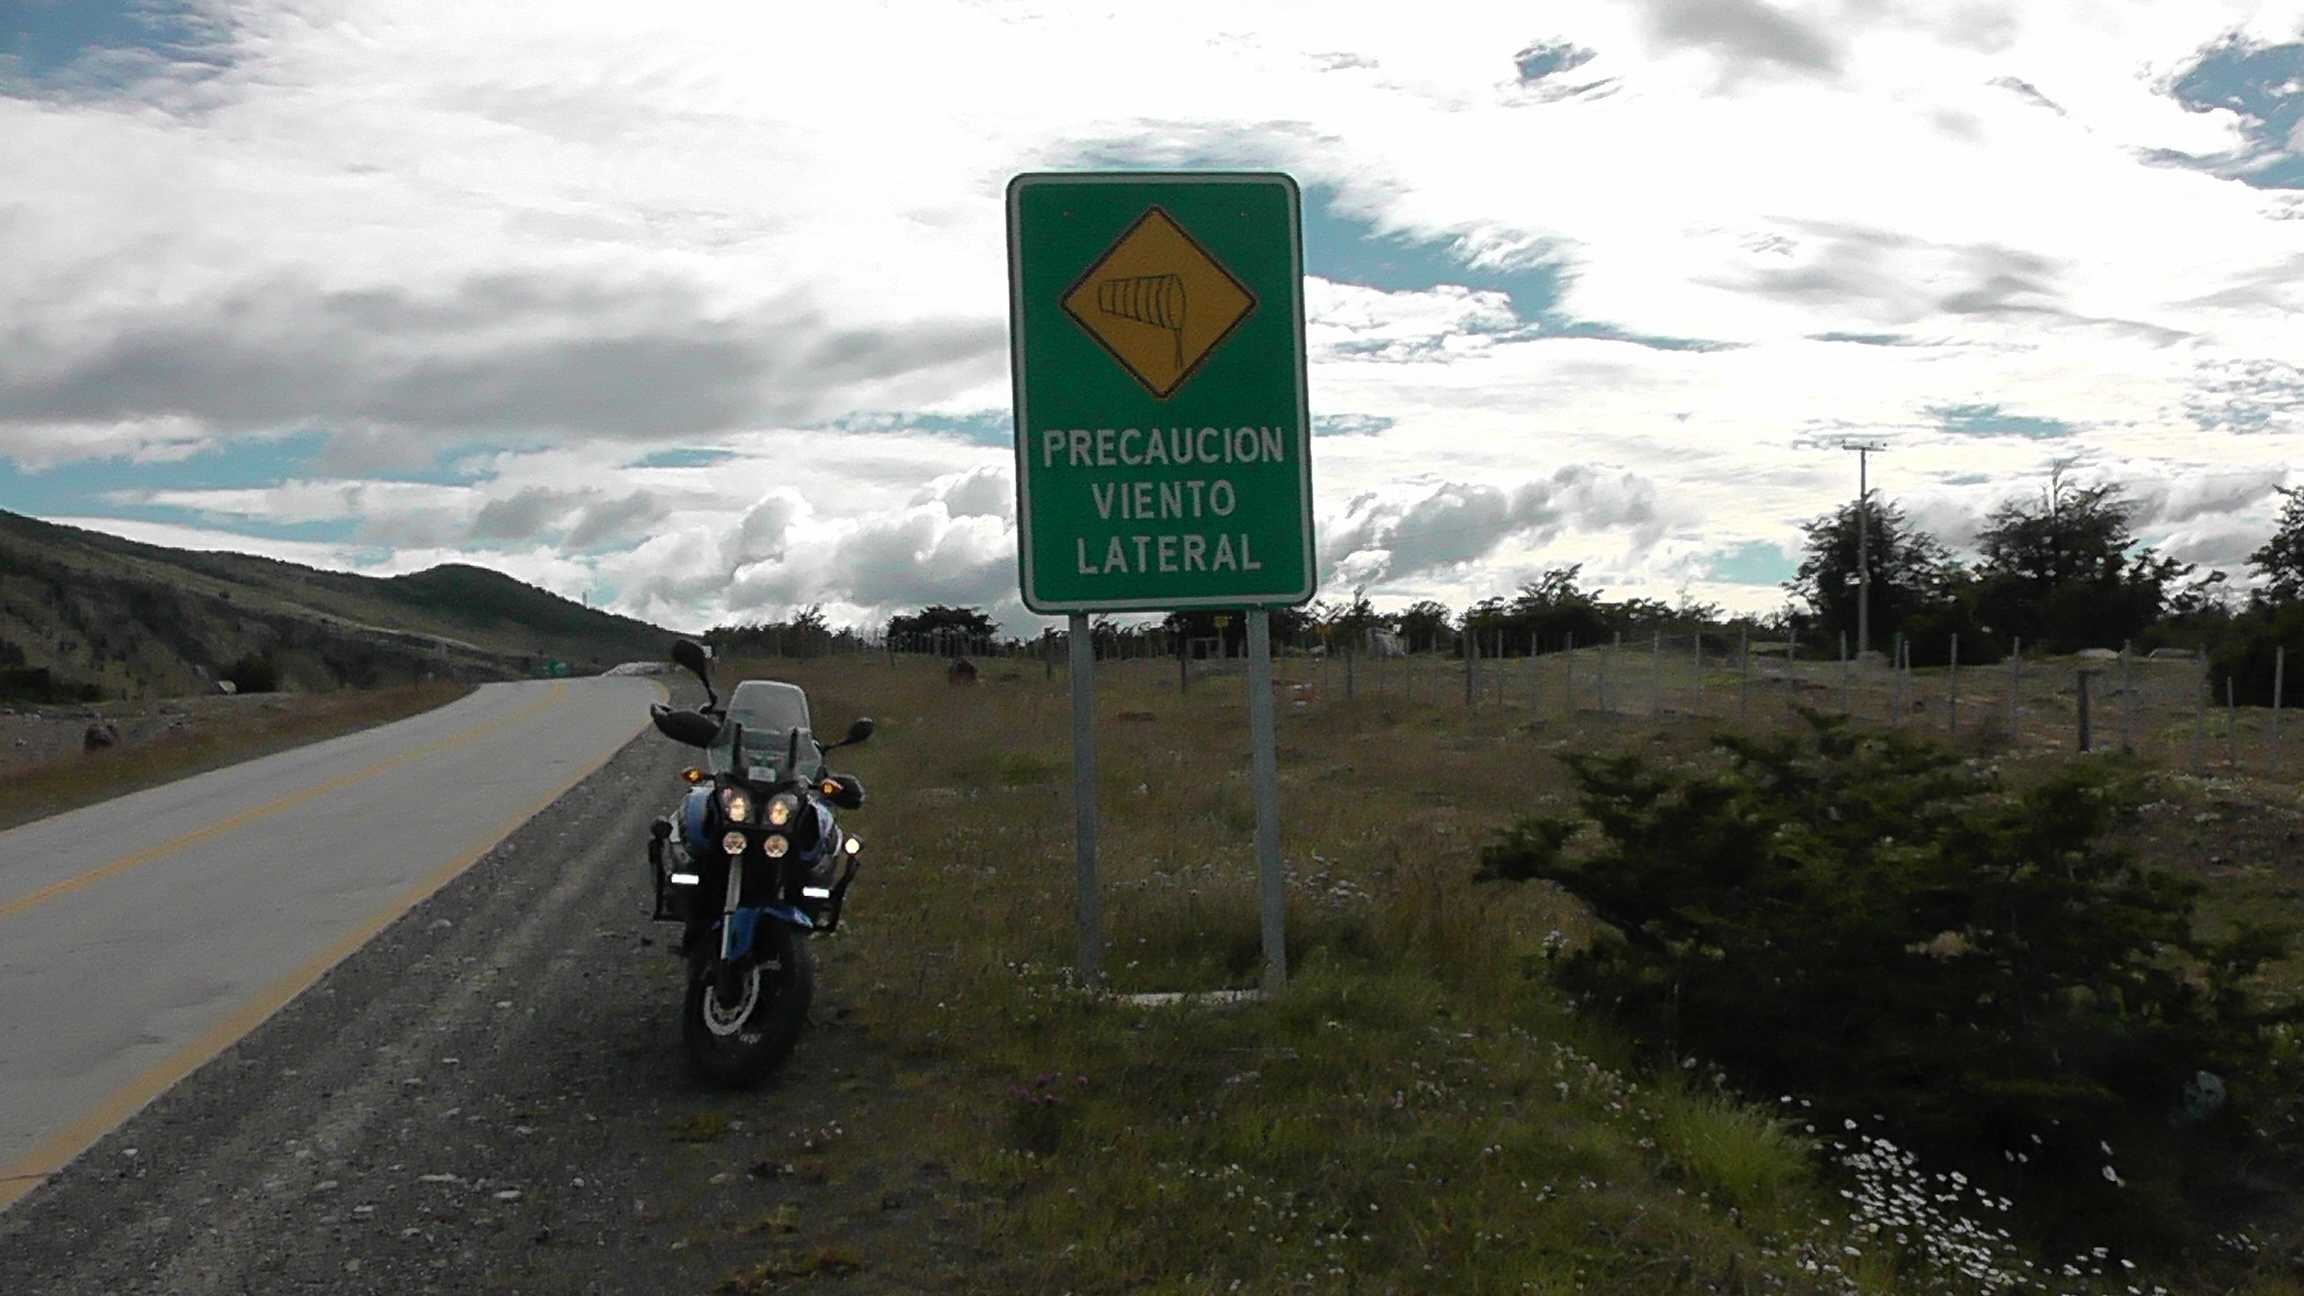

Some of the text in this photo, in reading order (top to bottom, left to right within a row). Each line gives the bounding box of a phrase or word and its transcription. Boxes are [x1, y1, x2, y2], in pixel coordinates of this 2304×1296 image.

[1043, 426, 1284, 466] PRECAUCION
[1092, 480, 1235, 519] VIENTO
[1077, 534, 1262, 574] LATERAL
